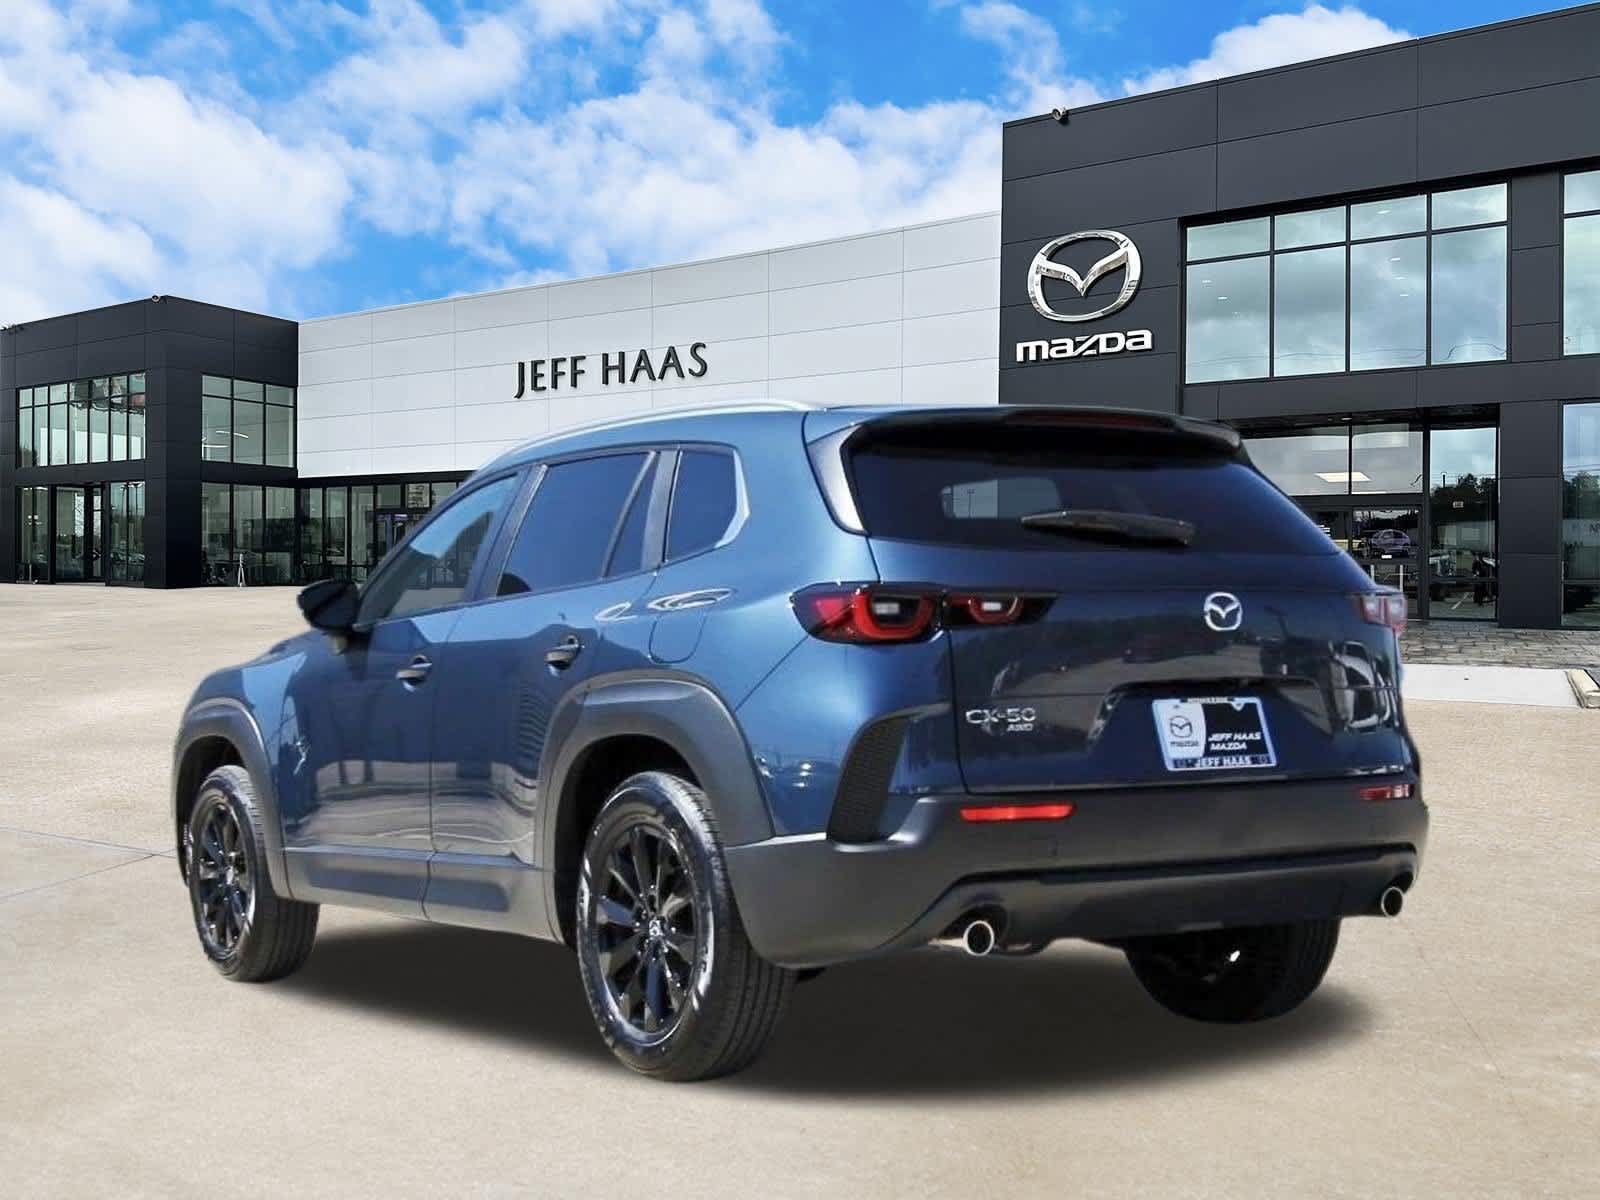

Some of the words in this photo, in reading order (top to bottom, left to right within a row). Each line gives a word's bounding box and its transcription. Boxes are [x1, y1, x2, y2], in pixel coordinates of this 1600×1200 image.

[514, 355, 587, 399] JEFF
[601, 341, 708, 386] HAAS
[965, 707, 1036, 724] CX-50
[1208, 733, 1232, 742] JEFF
[1233, 732, 1262, 741] HAAS
[1210, 742, 1247, 750] MAZDA
[1195, 757, 1222, 768] JEFF
[1223, 755, 1252, 766] HAAS
